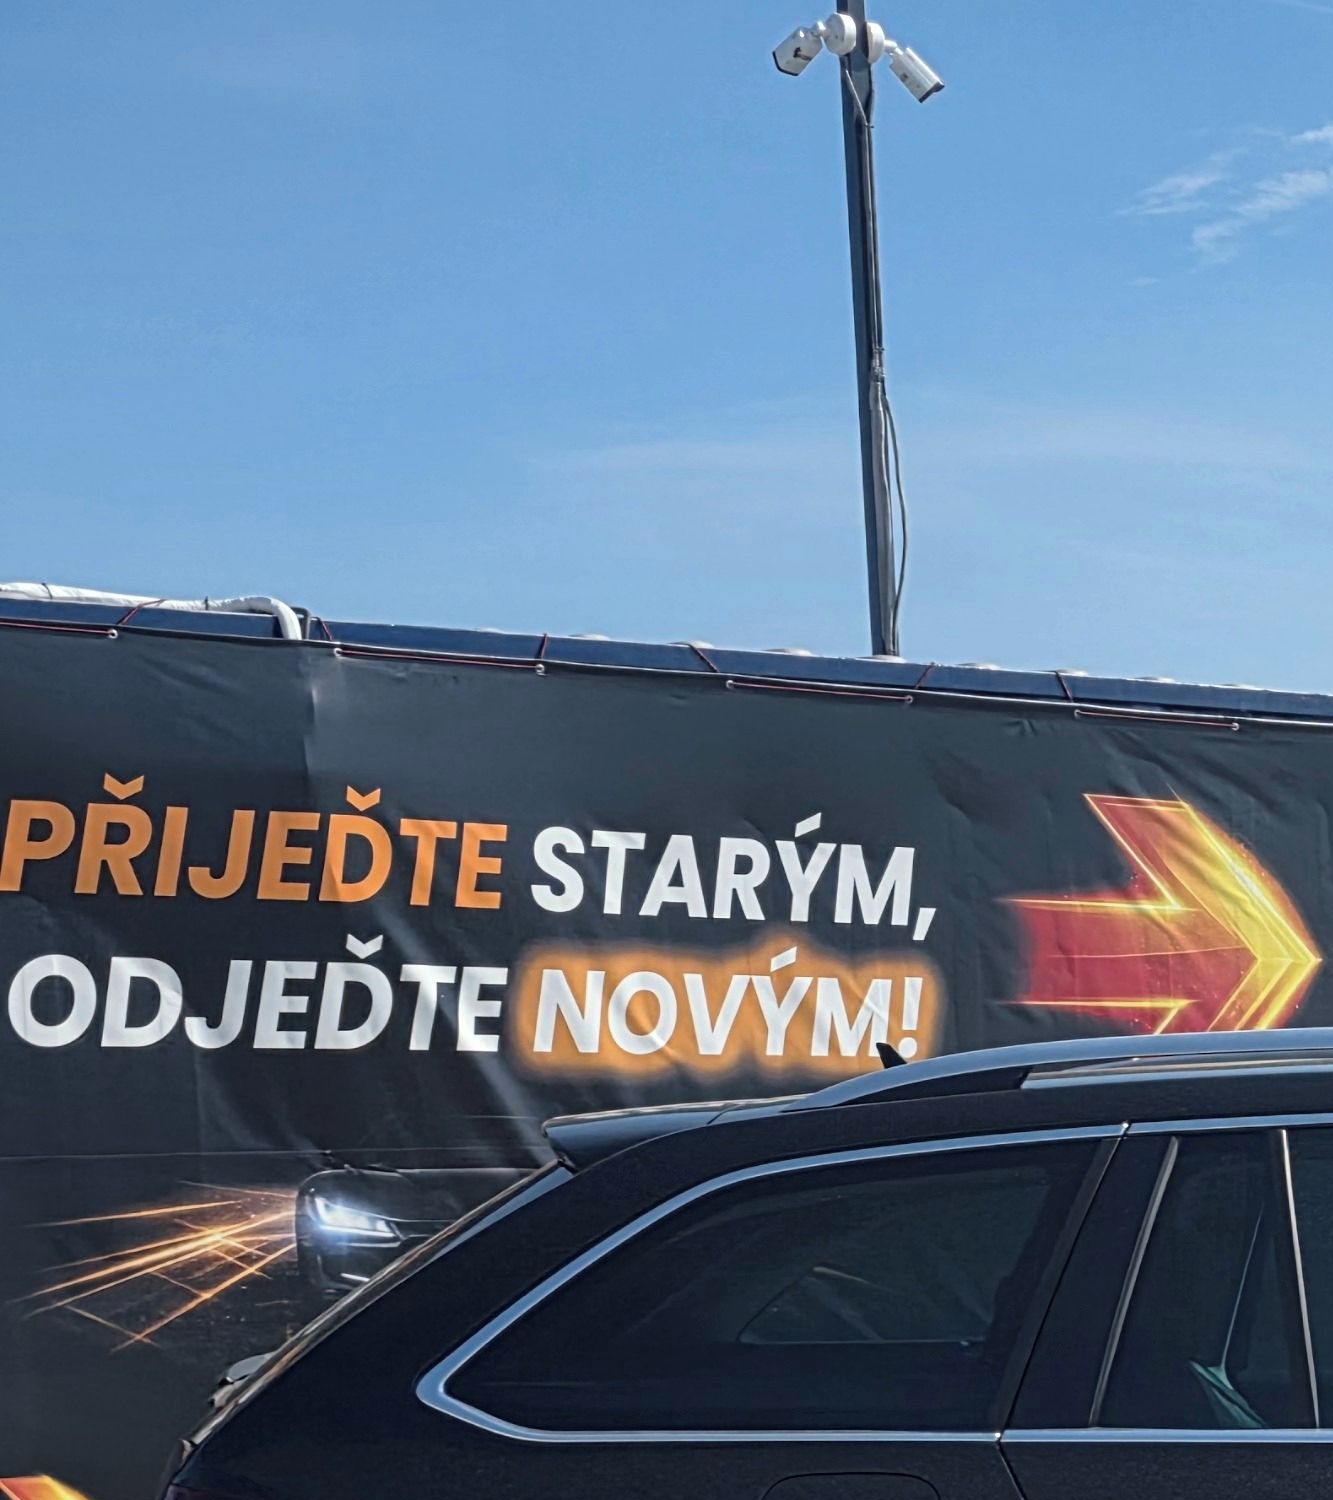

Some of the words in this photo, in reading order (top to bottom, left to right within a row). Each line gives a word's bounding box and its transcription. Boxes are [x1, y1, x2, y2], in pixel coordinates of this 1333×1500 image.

[0, 775, 508, 910] PŘIJEĎTE
[530, 812, 937, 941] STARÝM,
[8, 933, 509, 1053] ODJEĎTE
[533, 946, 924, 1059] NOVÝM!
